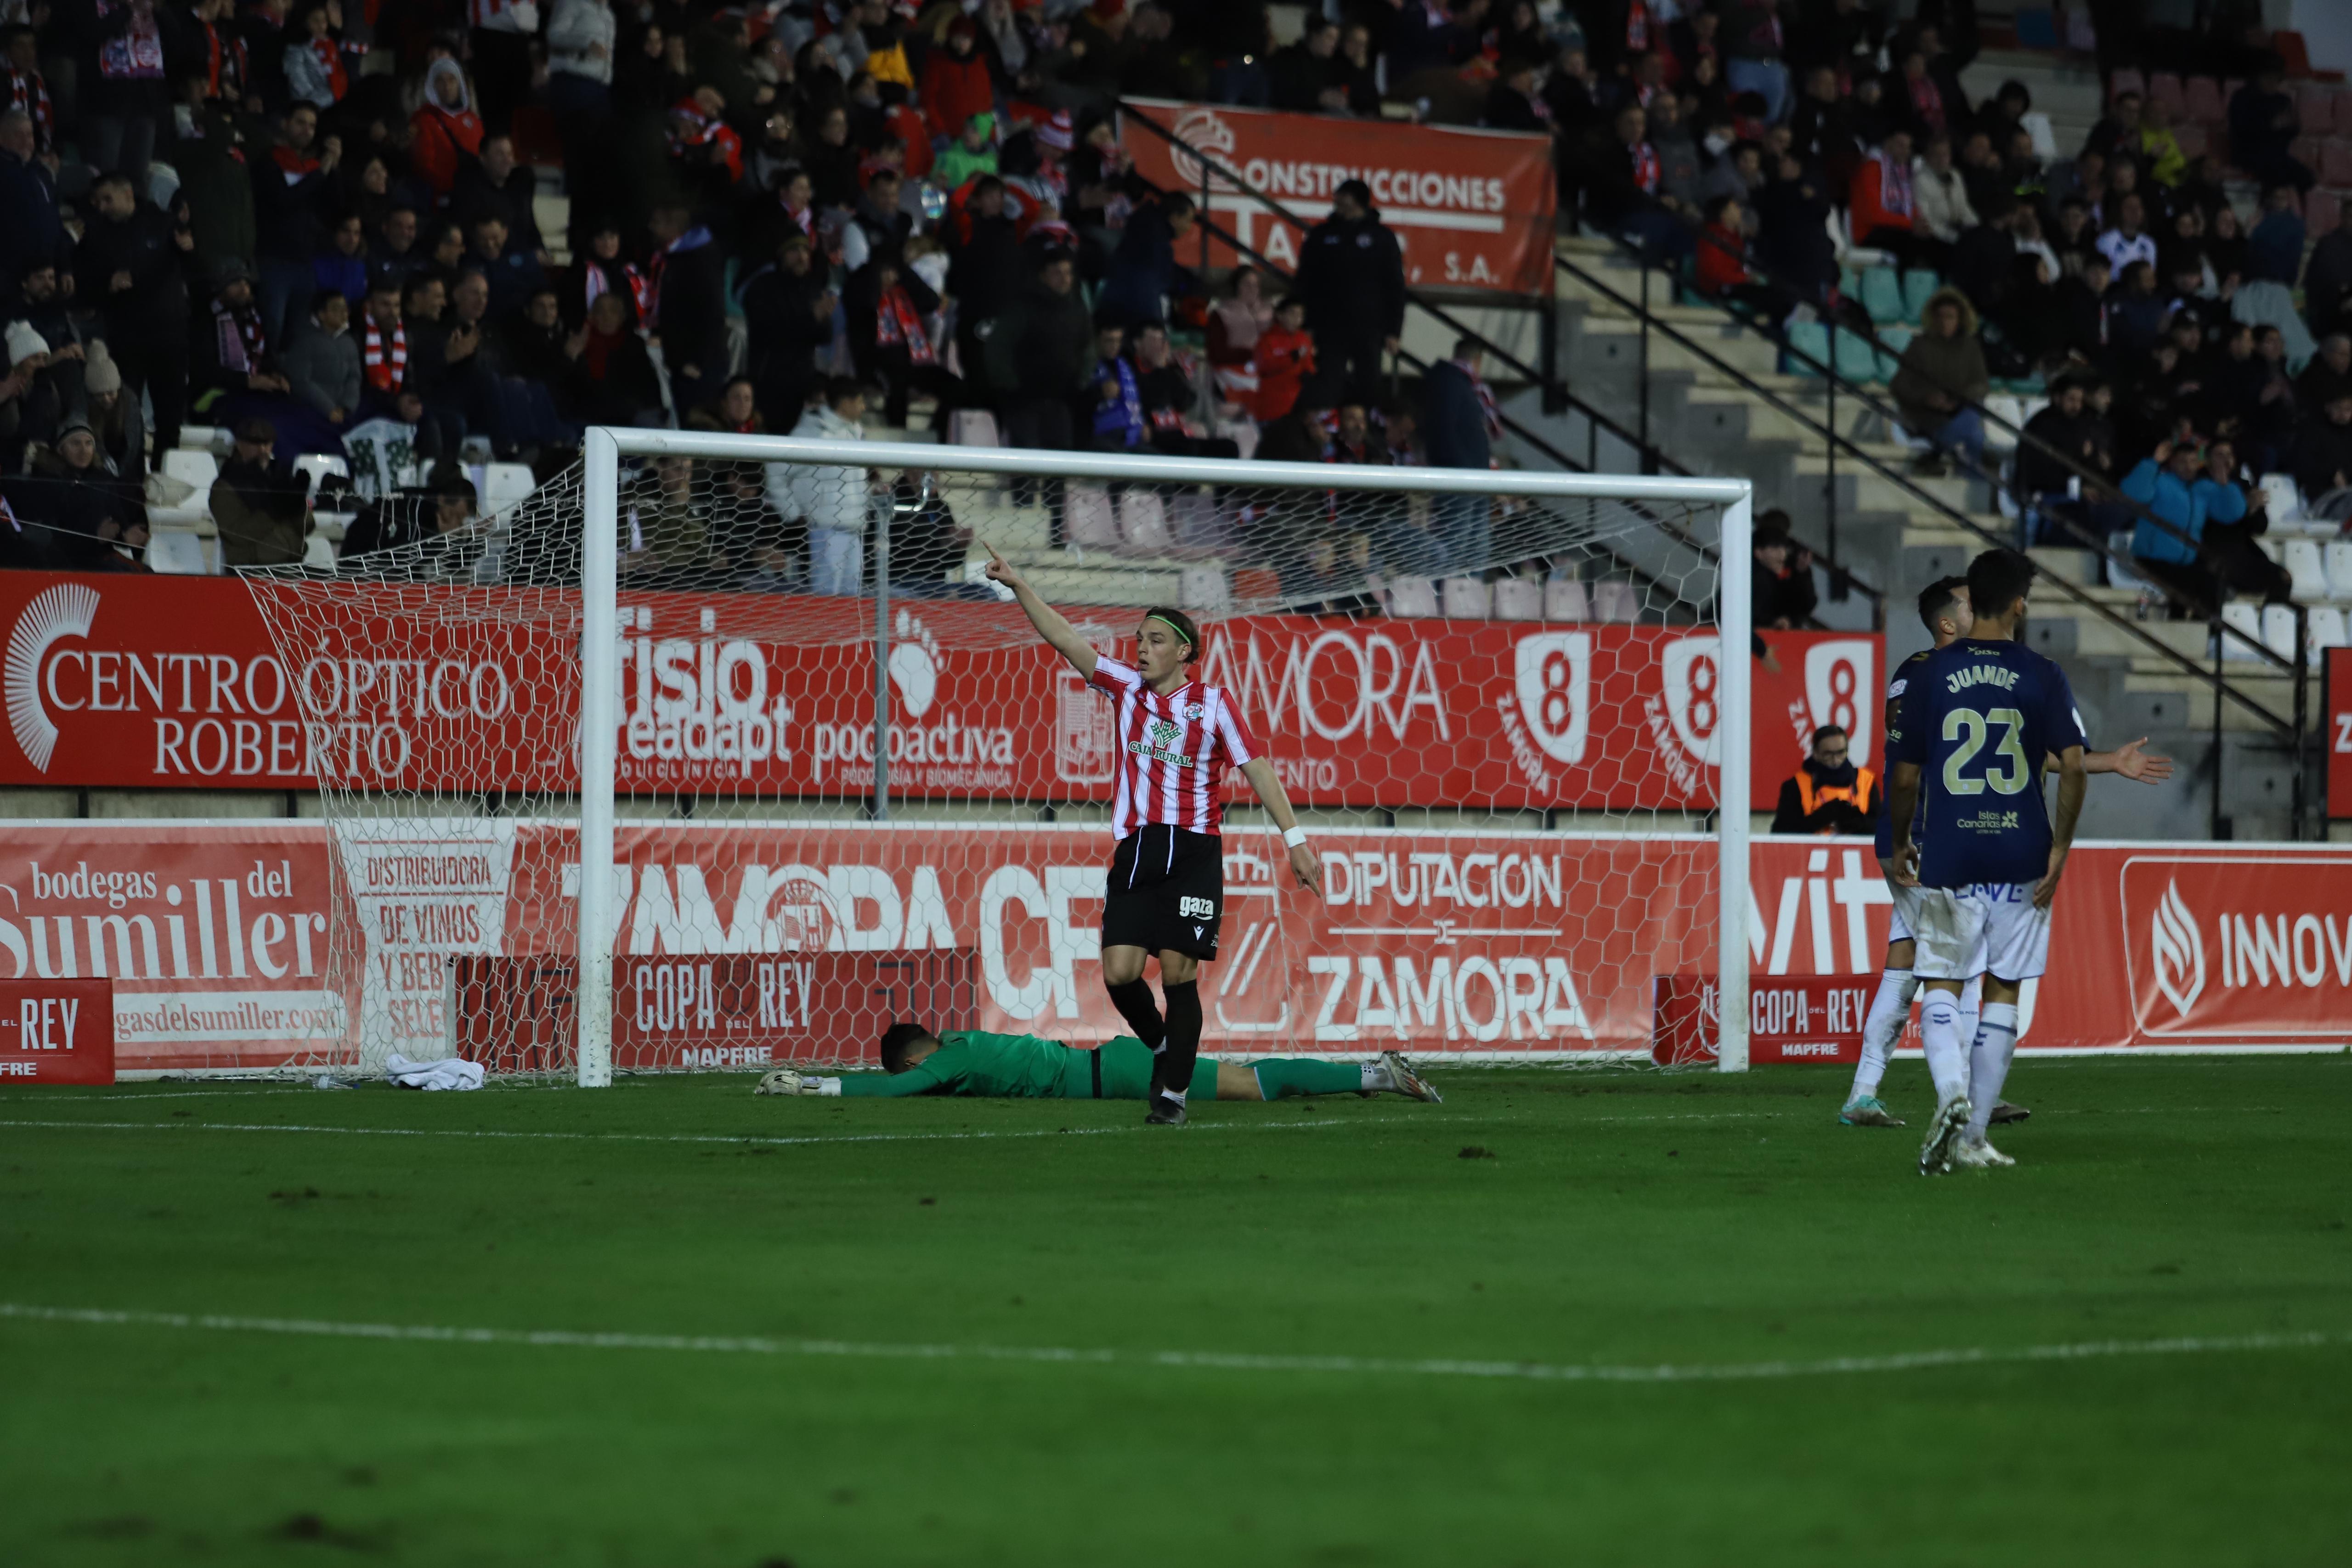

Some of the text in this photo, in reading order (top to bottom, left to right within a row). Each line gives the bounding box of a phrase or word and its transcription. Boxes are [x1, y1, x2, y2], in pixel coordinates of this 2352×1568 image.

[46, 636, 508, 719] CENTRO ÓPTICO
[1202, 629, 1449, 740] AMORA
[1946, 665, 2020, 693] JUANDE
[153, 717, 409, 778] ROBERTO
[1129, 741, 1193, 767] CAJA RURAL
[1496, 690, 1550, 797] ZAMORA
[1643, 695, 1696, 799] ZAMORA
[1942, 708, 2029, 795] 23
[1956, 818, 2001, 829] Canarias
[30, 859, 293, 909] bodegas del
[368, 856, 492, 886] DISTRIBUIDORA
[380, 903, 481, 944] DE VINOS
[1179, 896, 1214, 917] gaza
[979, 864, 1108, 1020] CF
[635, 964, 716, 1032] COPA
[759, 962, 813, 1028] REY
[1307, 956, 1594, 1042] ZAMORA
[1752, 989, 1809, 1034] COPA
[1827, 988, 1866, 1033] REY
[21, 998, 79, 1050] REY
[1782, 1043, 1838, 1056] MAPFRE
